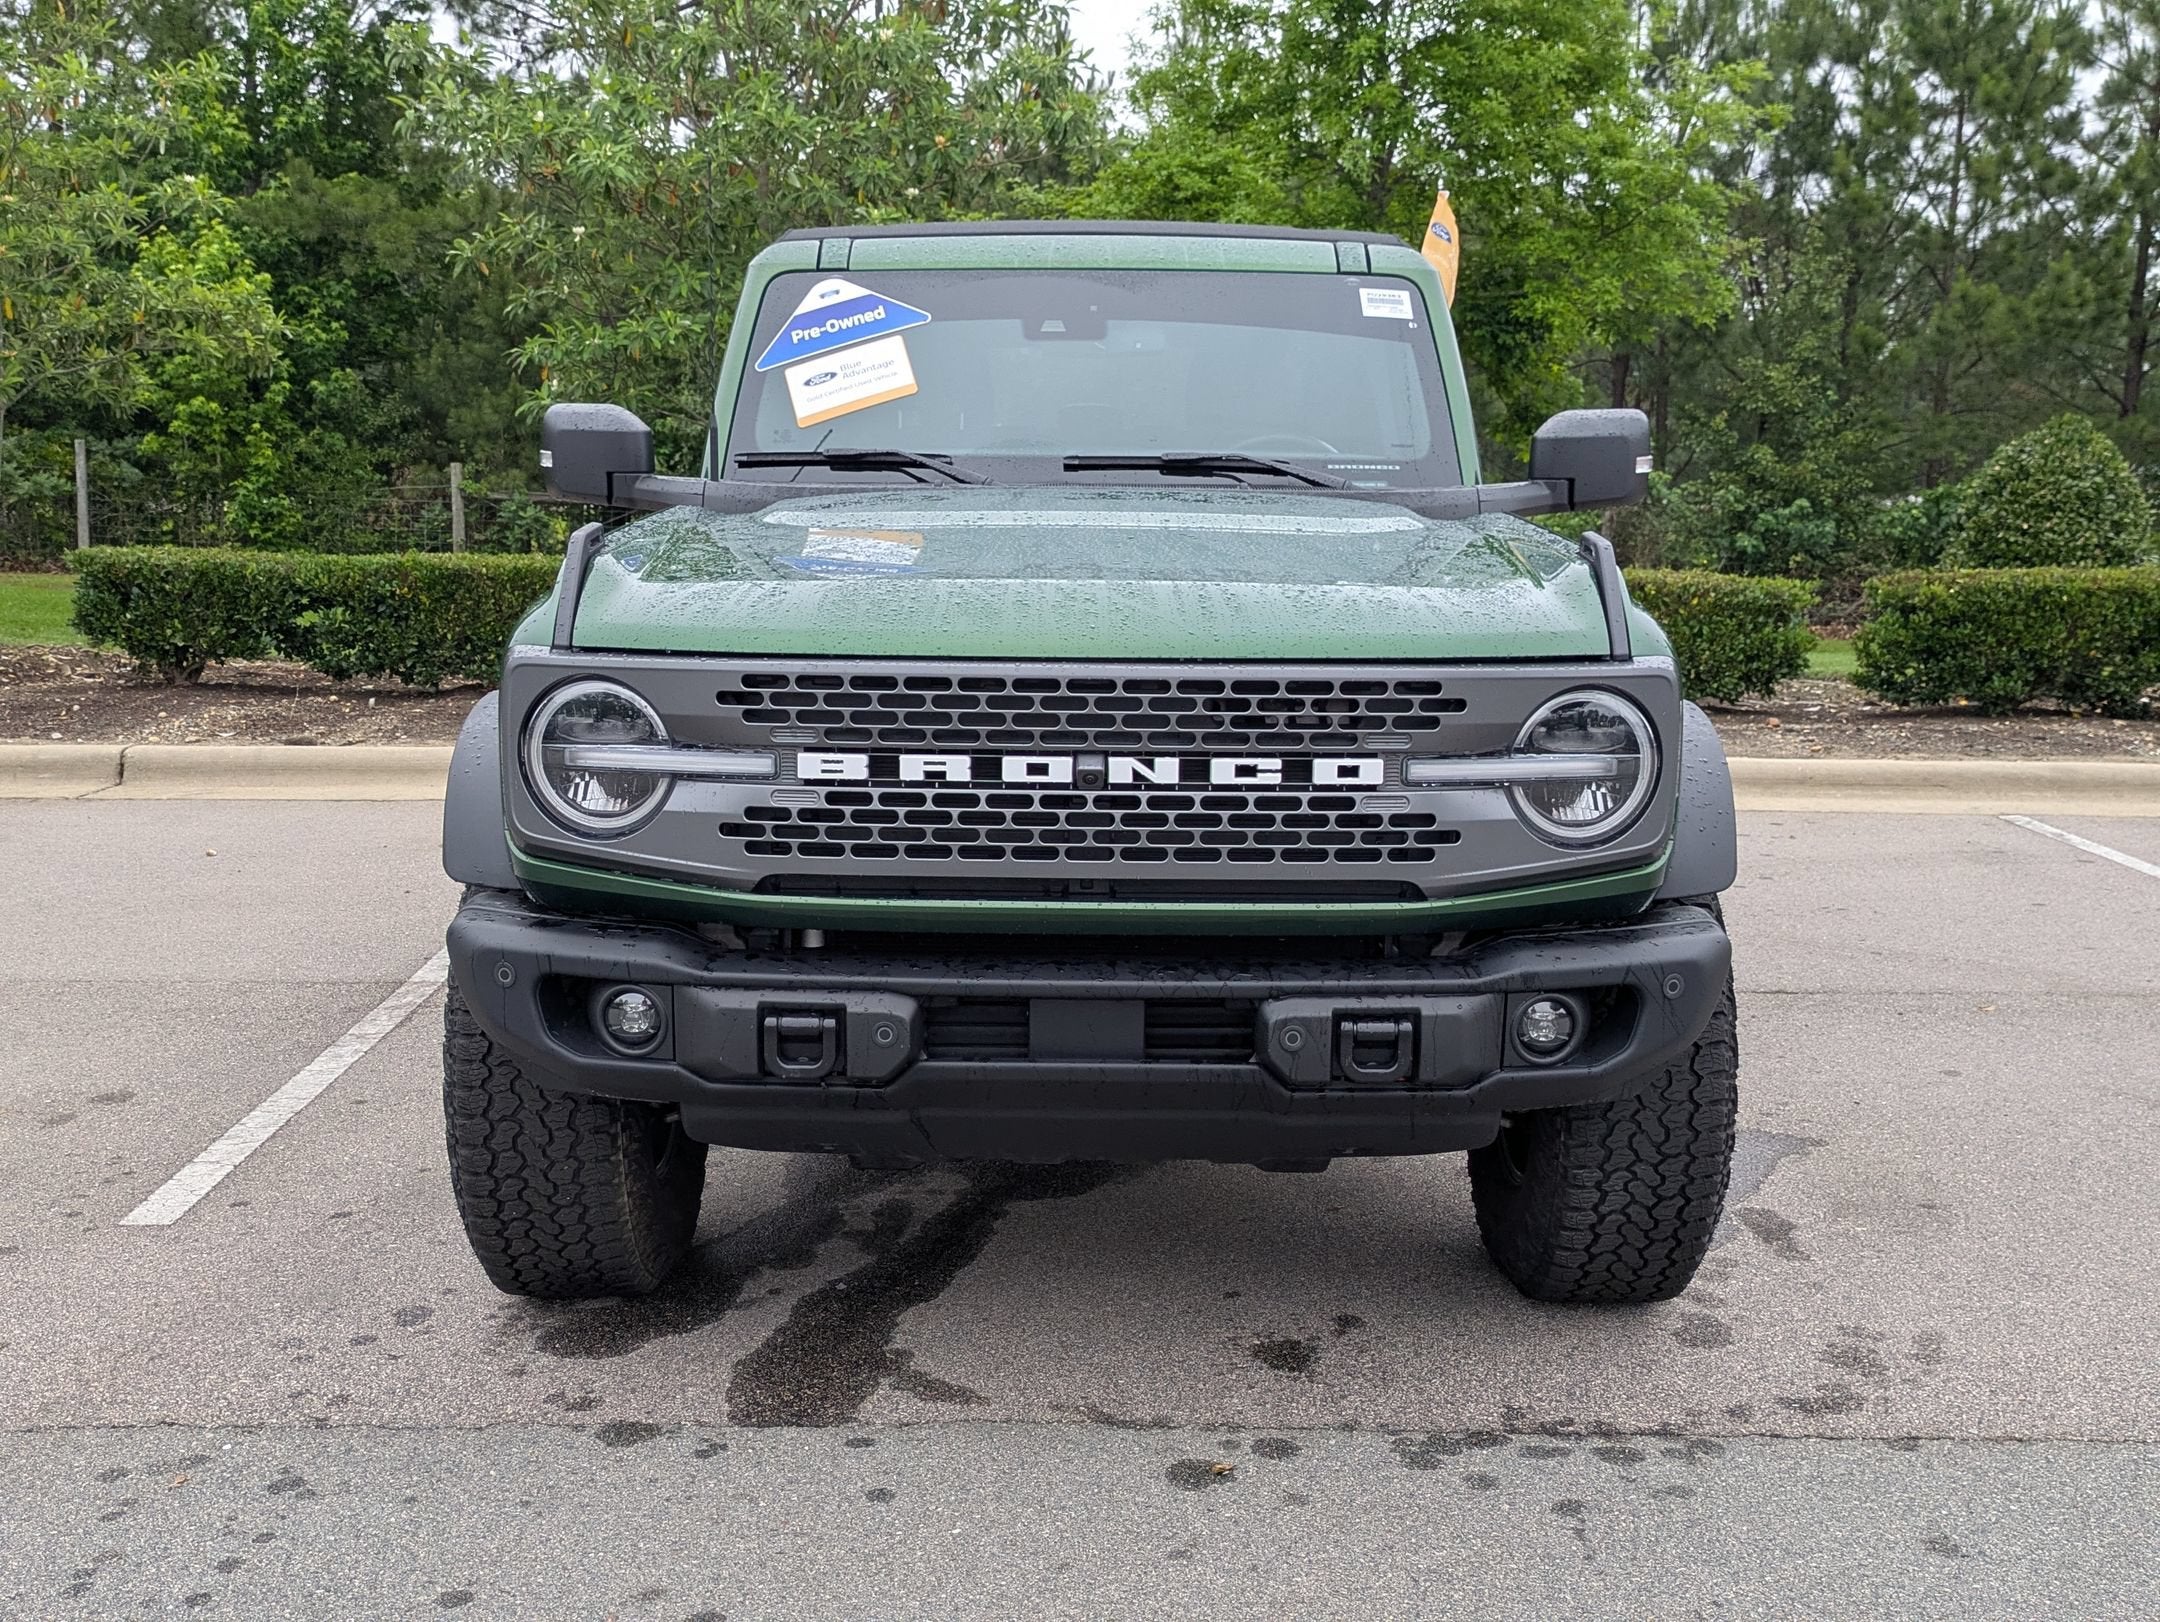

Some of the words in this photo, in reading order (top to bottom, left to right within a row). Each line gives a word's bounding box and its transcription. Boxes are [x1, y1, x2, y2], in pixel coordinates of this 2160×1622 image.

[1432, 223, 1450, 241] Ford
[791, 305, 886, 344] Pre-Owned
[839, 360, 862, 372] Blue
[842, 359, 895, 380] Advantage
[808, 373, 833, 386] Ford
[797, 752, 1384, 785] BRONCO
